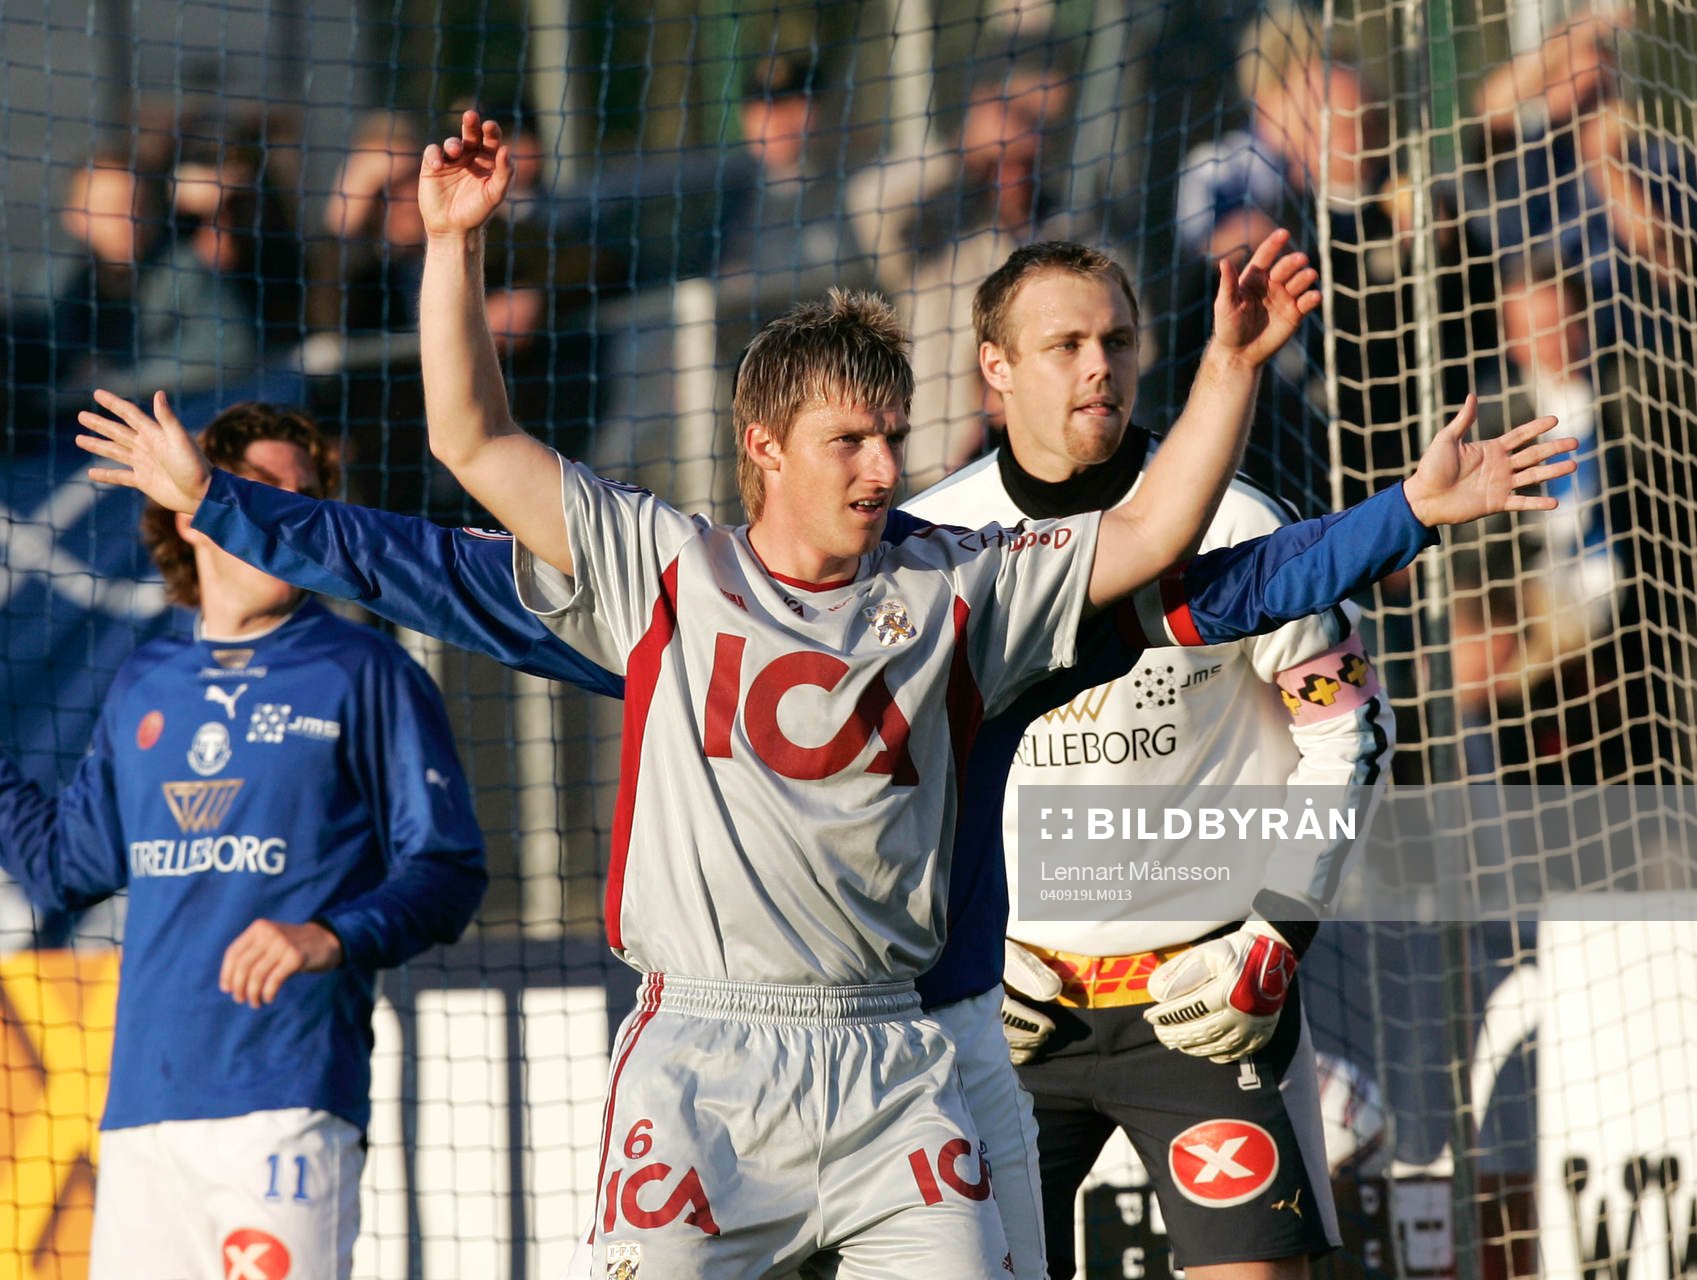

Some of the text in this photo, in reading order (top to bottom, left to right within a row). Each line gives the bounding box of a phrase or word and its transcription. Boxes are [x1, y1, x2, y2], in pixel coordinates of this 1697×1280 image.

[703, 632, 920, 786] ICA
[130, 835, 287, 878] TRELLEBORG
[624, 1119, 654, 1159] 6
[265, 1153, 309, 1199] 11
[603, 1162, 721, 1237] ICA
[908, 1138, 991, 1207] IC
